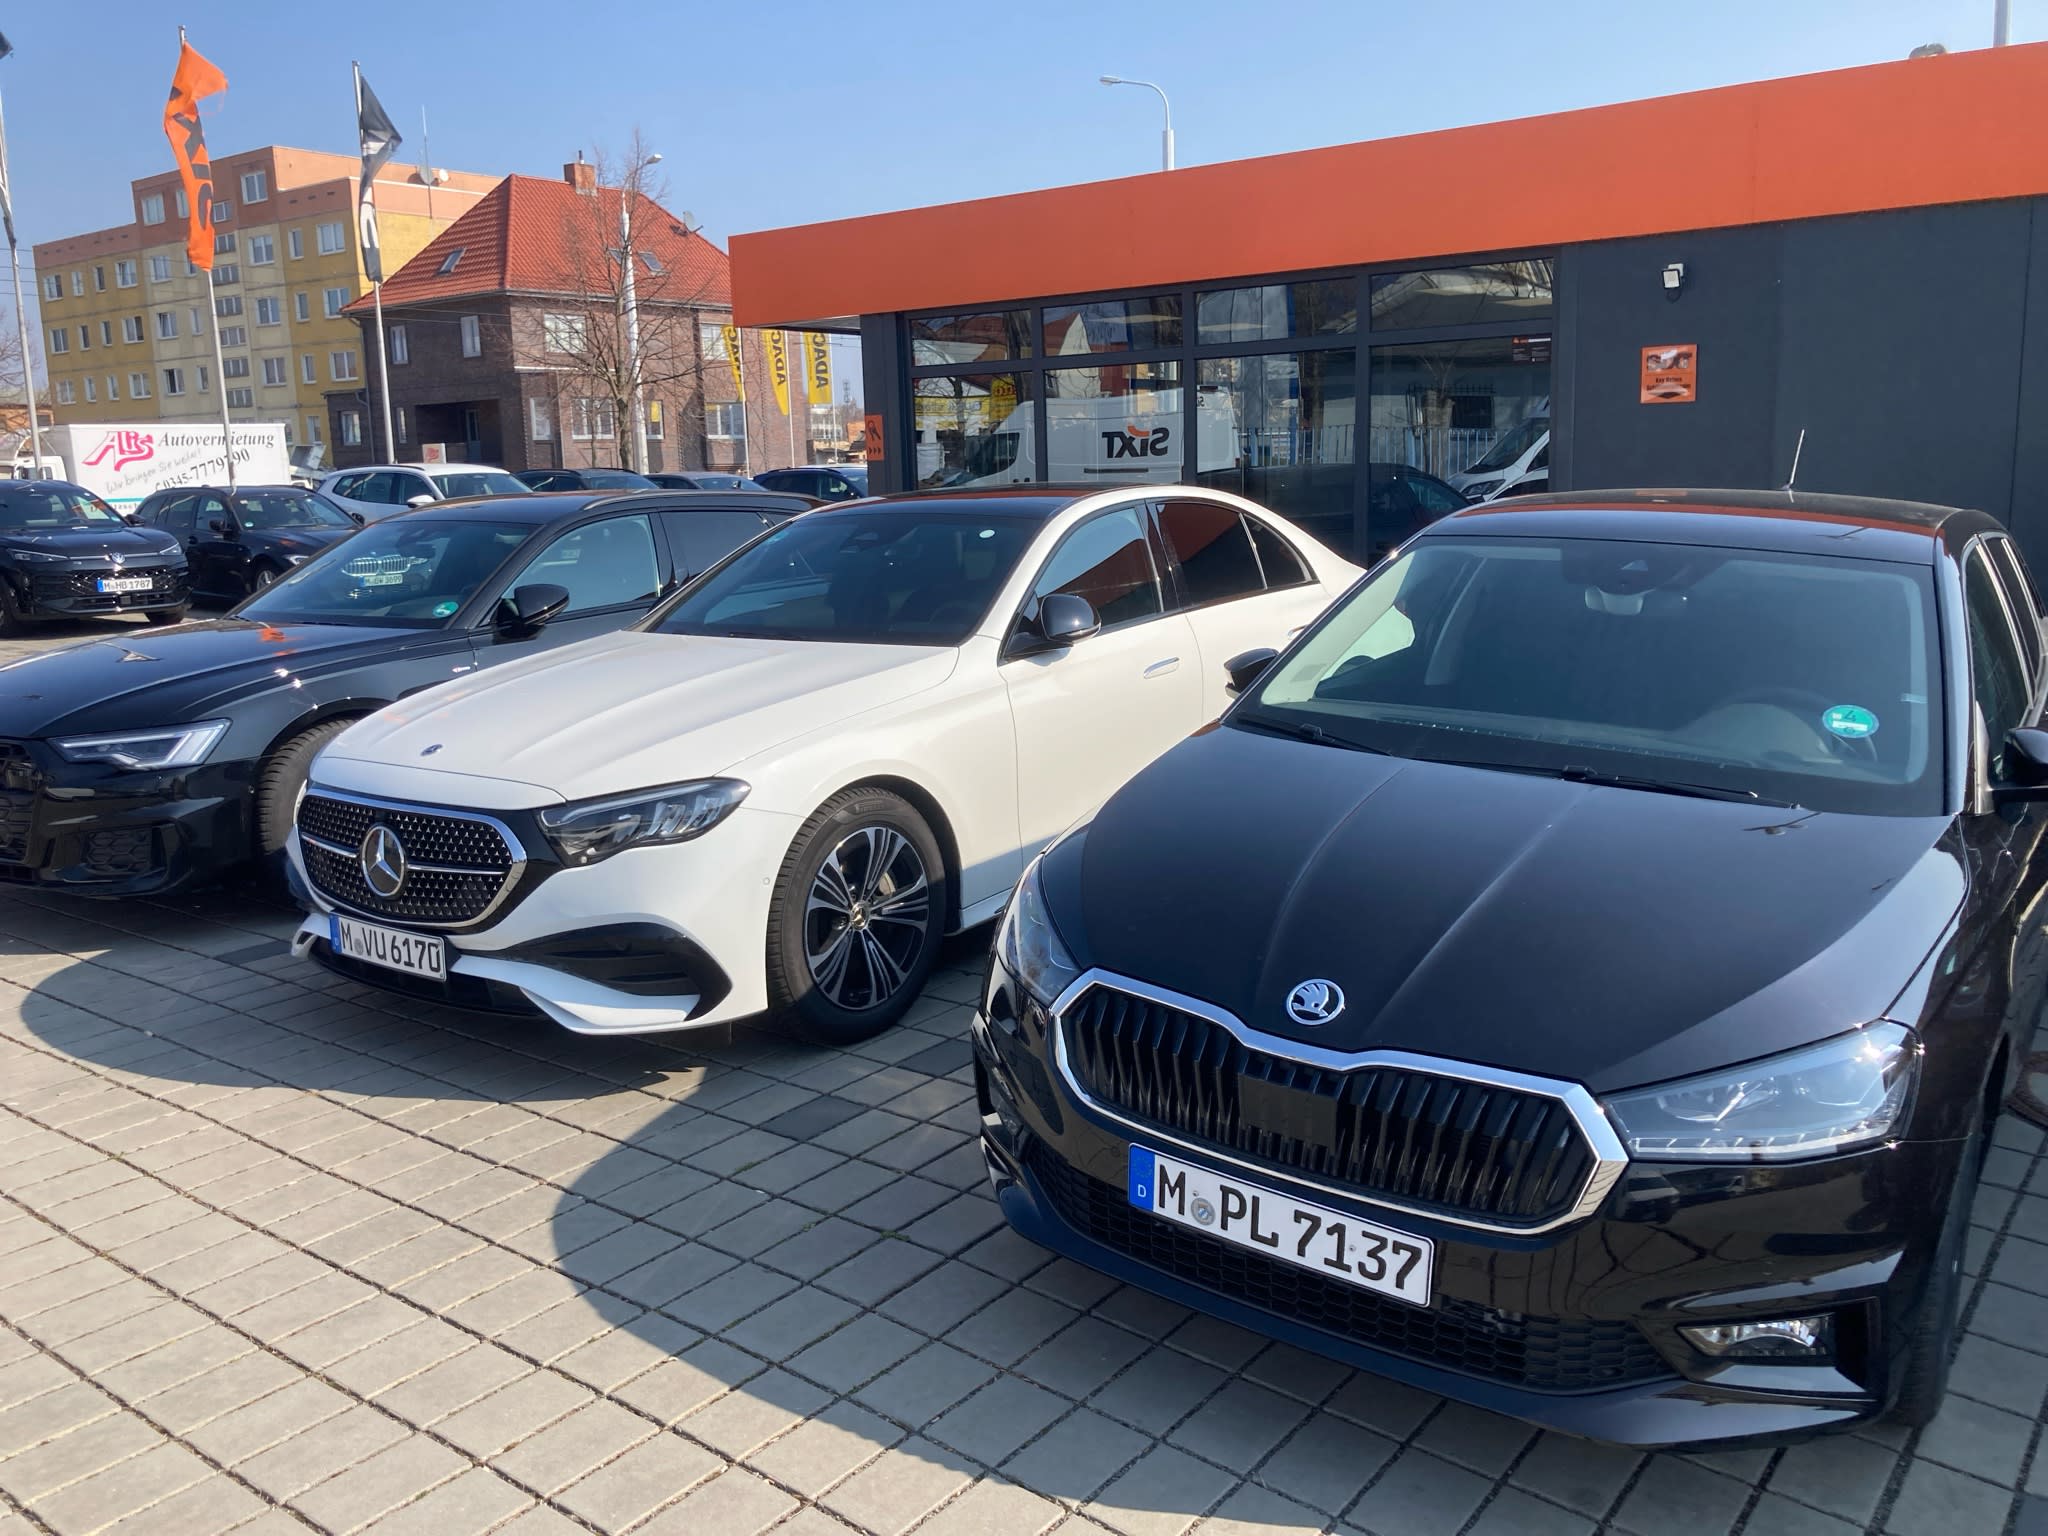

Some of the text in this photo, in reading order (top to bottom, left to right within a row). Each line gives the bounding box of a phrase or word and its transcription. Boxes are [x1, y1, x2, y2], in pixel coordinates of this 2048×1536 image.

[104, 582, 110, 590] M
[340, 921, 353, 951] M
[361, 927, 387, 961] VU
[390, 935, 441, 973] 6170
[1137, 1163, 1423, 1290] D M PL 7137
